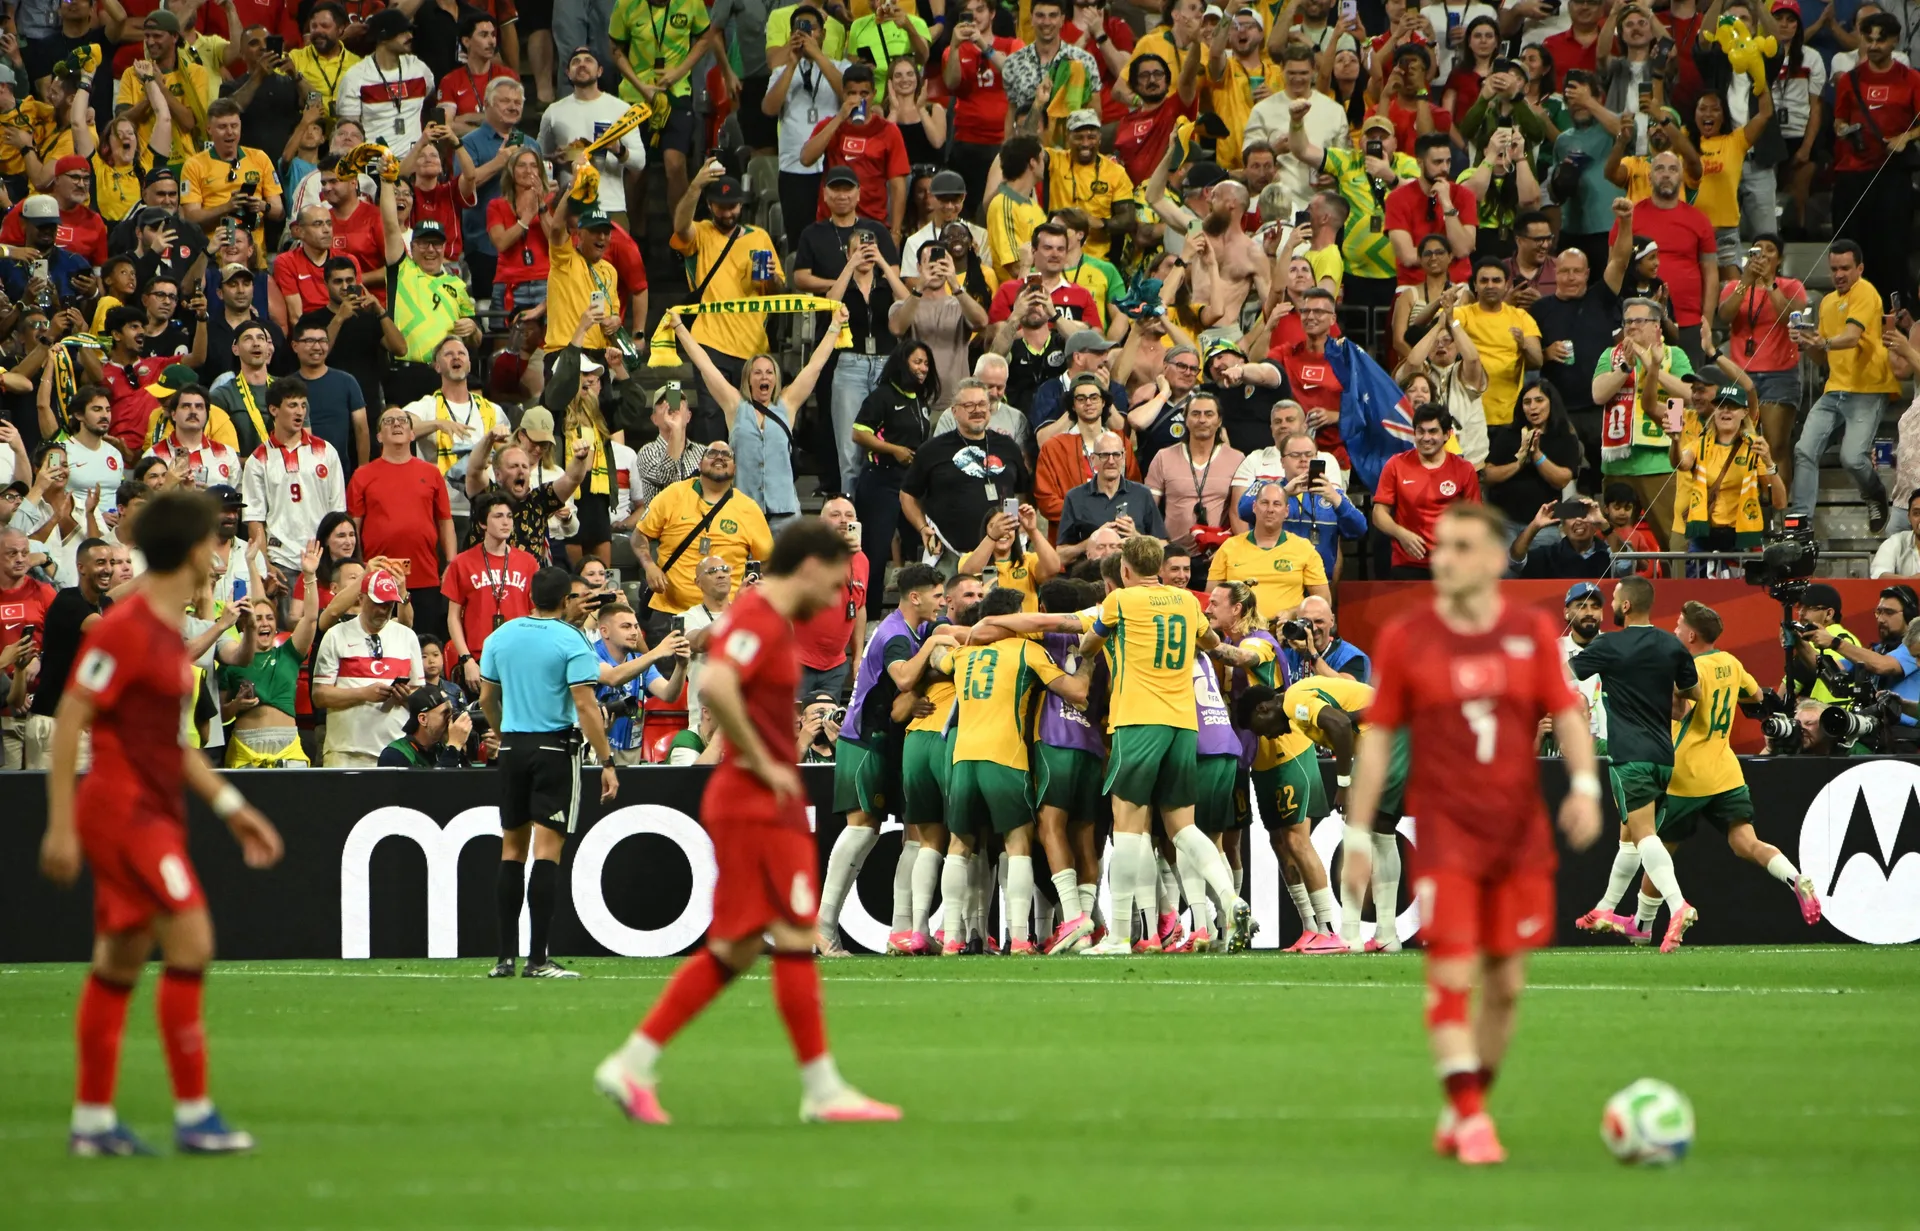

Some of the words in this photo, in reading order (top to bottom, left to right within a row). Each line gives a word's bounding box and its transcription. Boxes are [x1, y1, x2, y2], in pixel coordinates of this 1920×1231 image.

[592, 211, 607, 219] AUS
[423, 221, 439, 230] AUS
[432, 293, 441, 311] 9
[697, 299, 804, 313] AUSTRALIA
[1721, 387, 1737, 395] AUS
[290, 483, 302, 503] 9
[470, 569, 527, 592] CANADA
[1152, 614, 1187, 670] 19
[963, 649, 998, 701] 13
[1706, 686, 1731, 741] 14
[1276, 784, 1299, 812] 22
